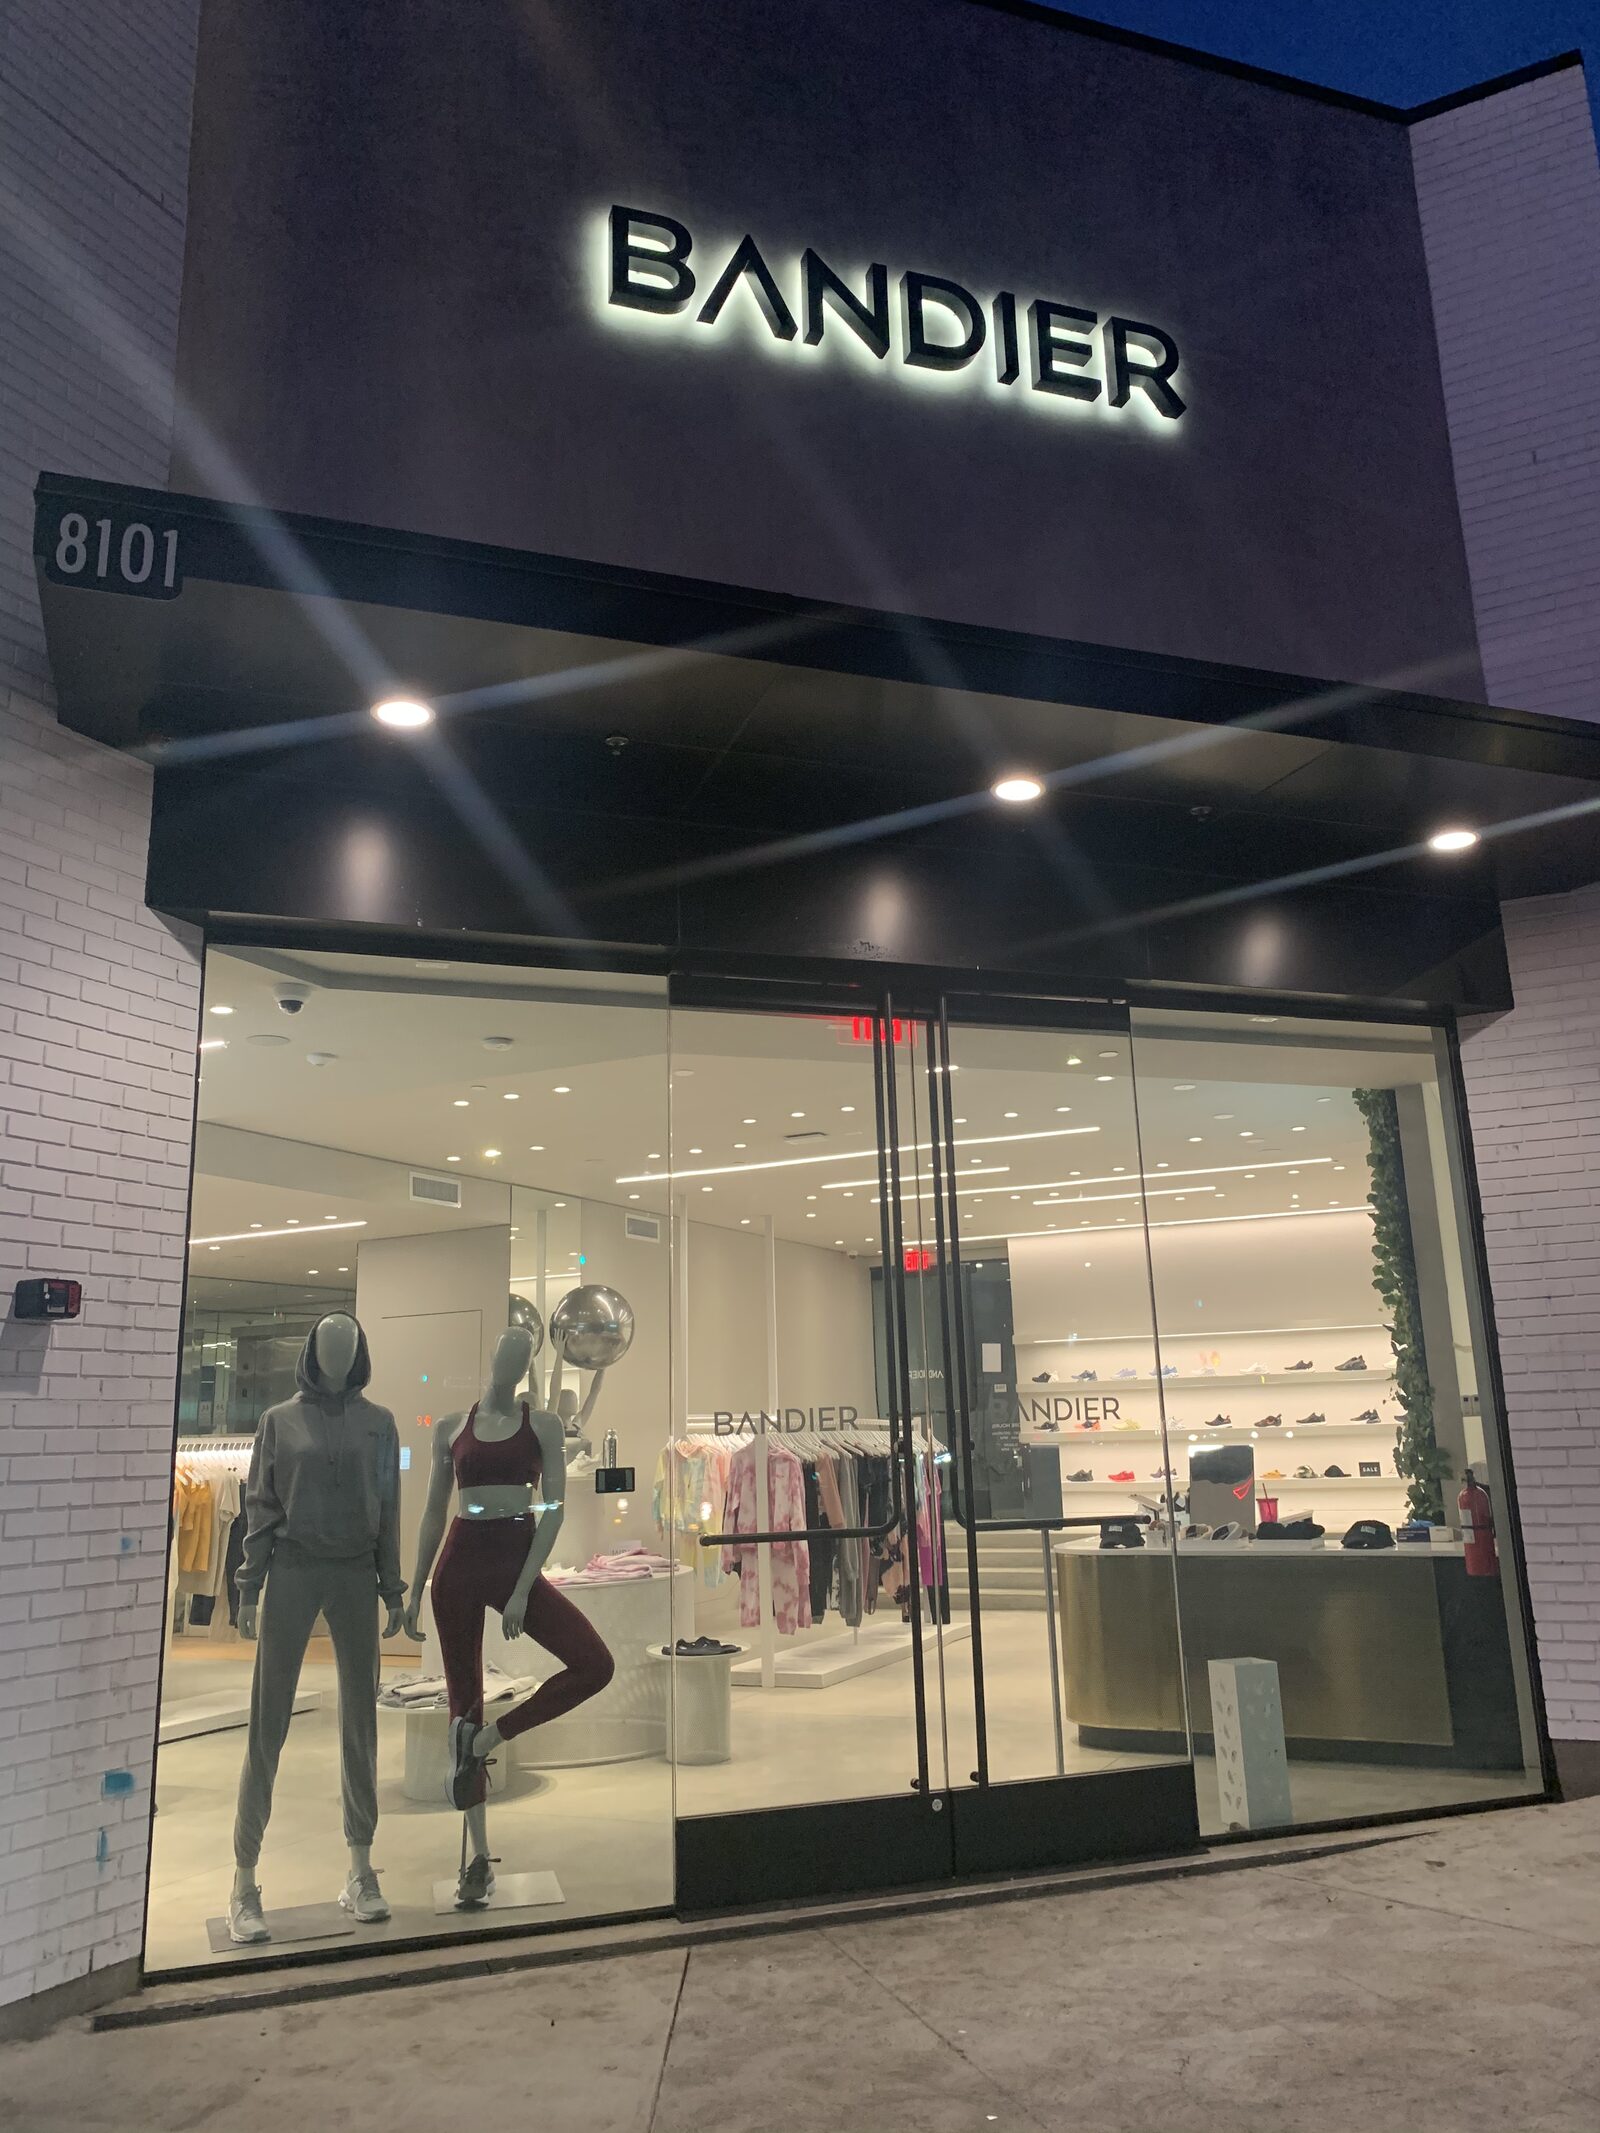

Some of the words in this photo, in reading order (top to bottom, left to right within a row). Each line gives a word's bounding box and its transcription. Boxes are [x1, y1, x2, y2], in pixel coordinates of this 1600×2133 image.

[608, 204, 1188, 419] BANDIER
[56, 512, 178, 588] 8101
[714, 1406, 859, 1436] BANDIER
